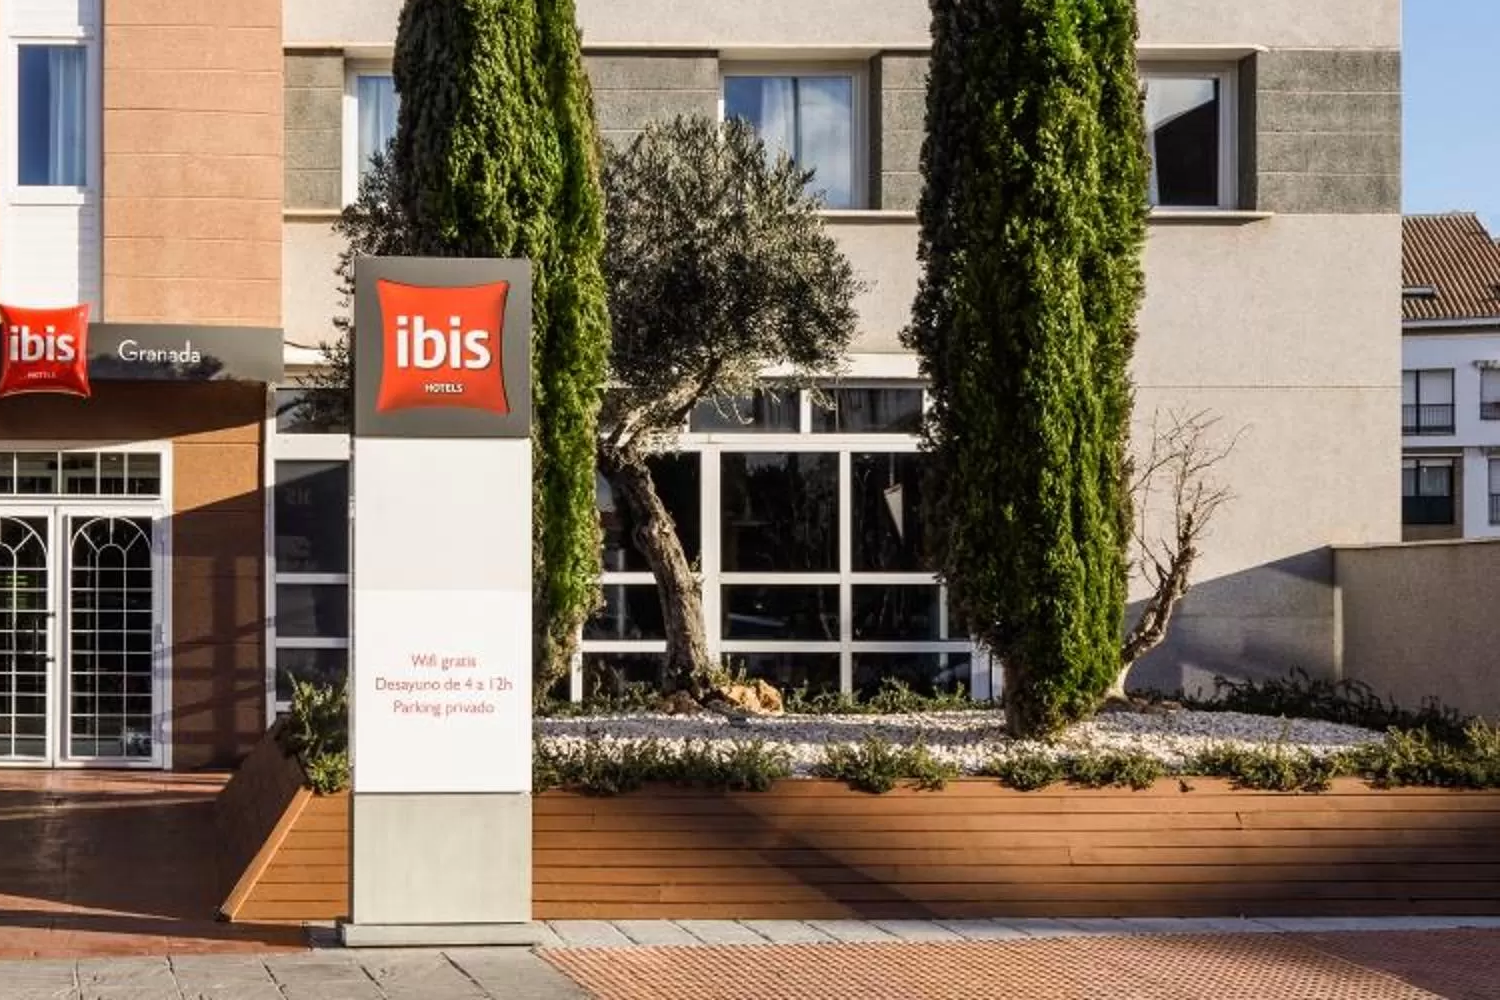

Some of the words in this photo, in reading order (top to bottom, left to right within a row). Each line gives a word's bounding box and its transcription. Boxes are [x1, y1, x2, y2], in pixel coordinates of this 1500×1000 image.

[9, 325, 75, 362] ibis
[118, 339, 201, 363] Granada
[396, 315, 492, 369] ibis
[425, 383, 464, 393] HOTELS
[412, 653, 437, 668] Wifi
[375, 677, 441, 694] Desayuno
[444, 676, 461, 691] de
[393, 700, 441, 718] Parking
[445, 700, 495, 717] privado
